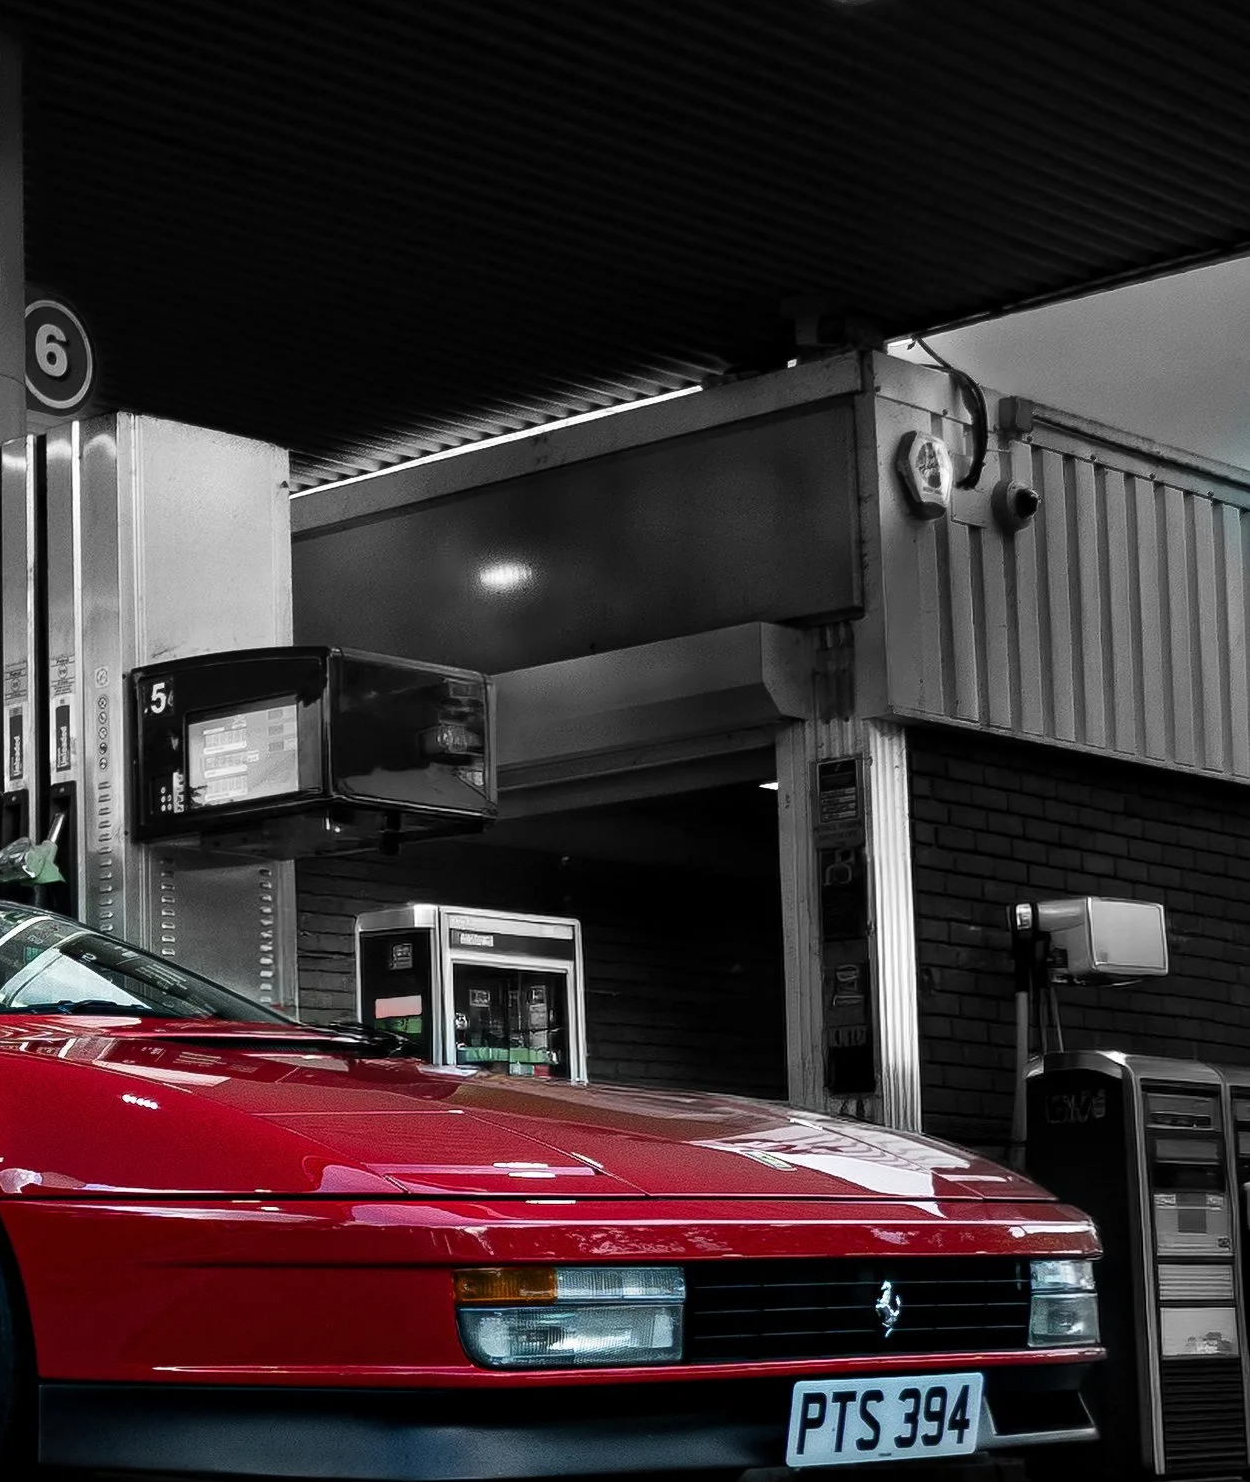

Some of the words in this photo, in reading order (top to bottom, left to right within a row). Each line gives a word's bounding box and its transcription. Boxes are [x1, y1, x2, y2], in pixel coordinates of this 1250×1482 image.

[34, 323, 69, 378] 6
[150, 681, 167, 714] 5
[795, 1389, 885, 1455] PTS
[893, 1384, 971, 1449] 394
